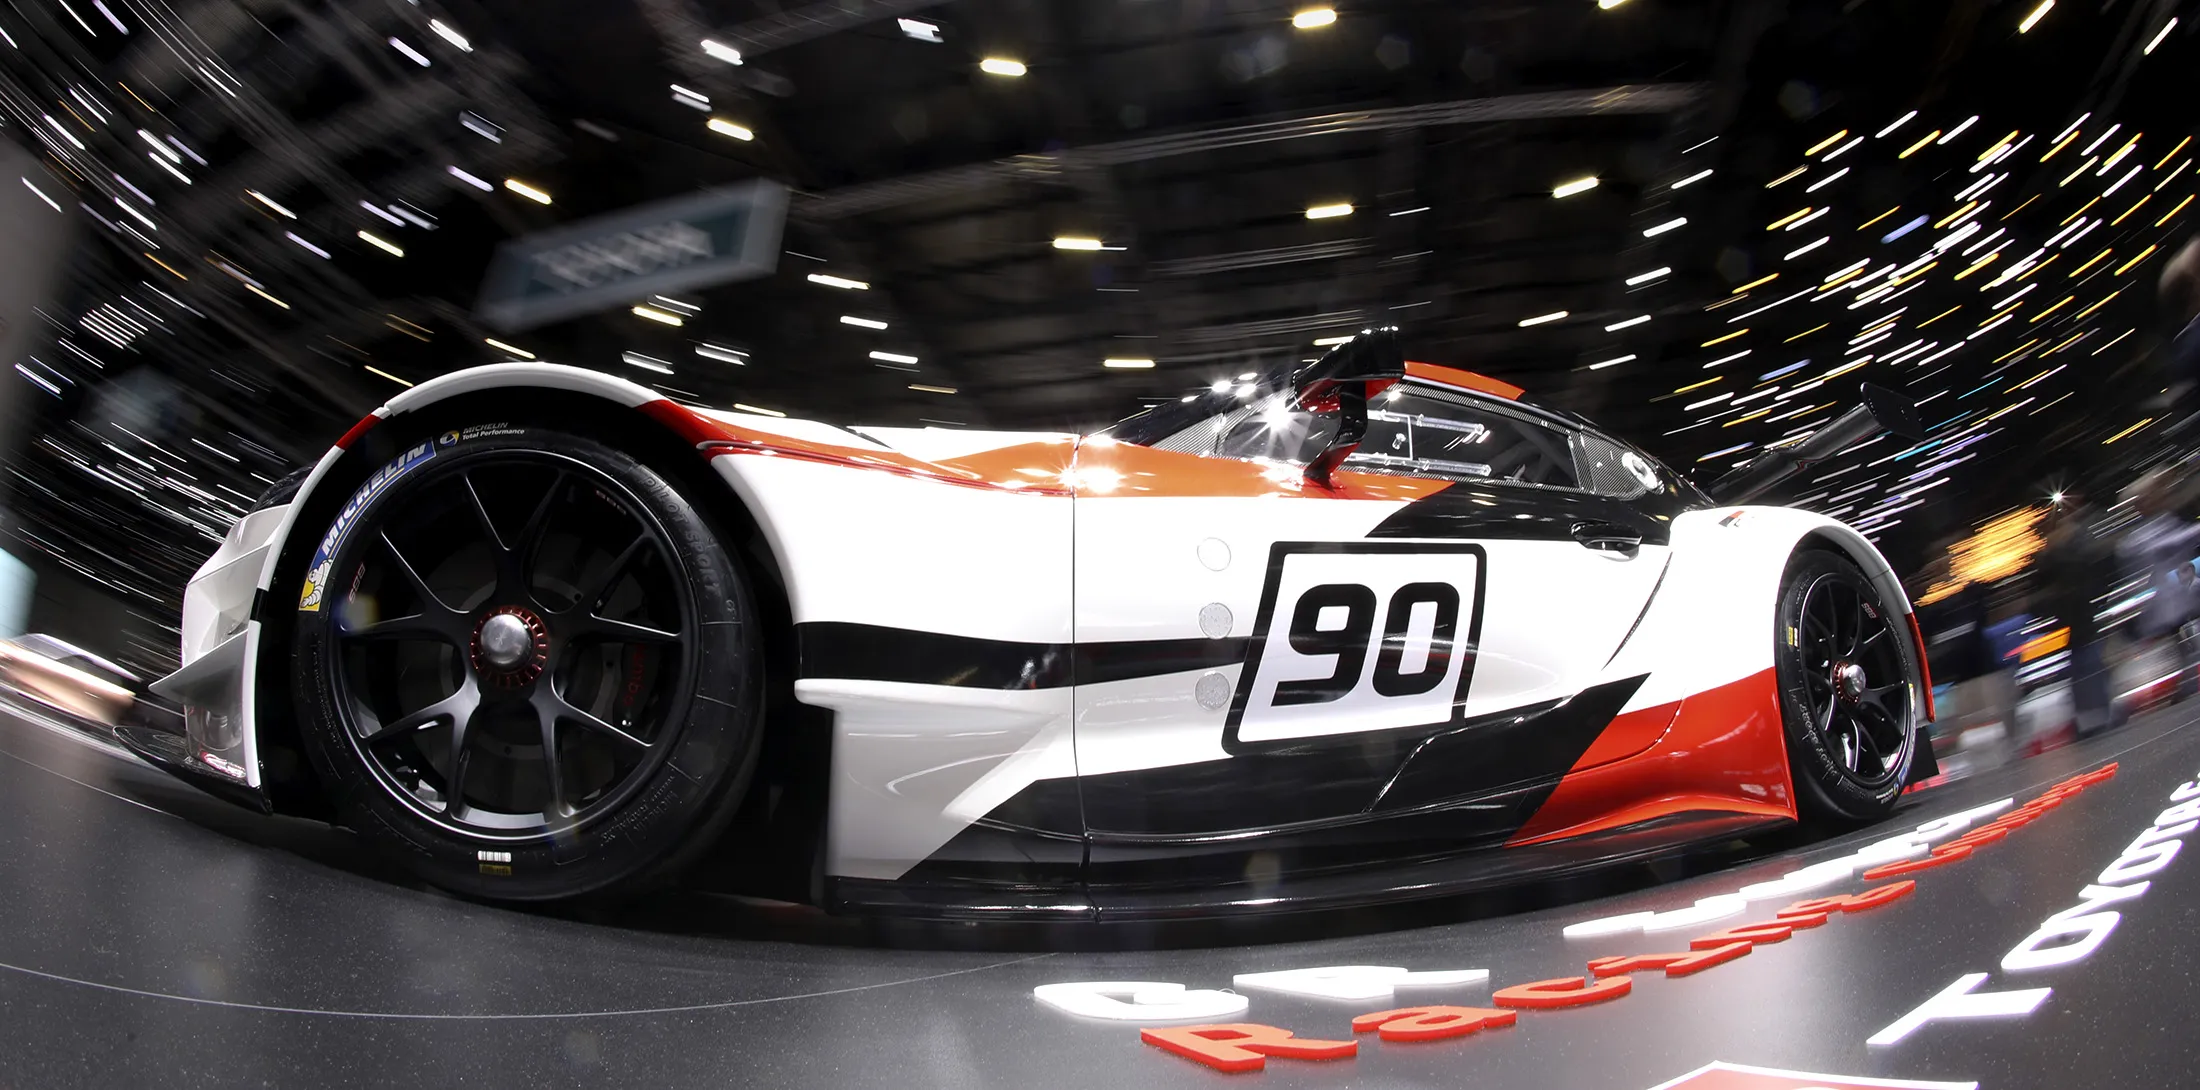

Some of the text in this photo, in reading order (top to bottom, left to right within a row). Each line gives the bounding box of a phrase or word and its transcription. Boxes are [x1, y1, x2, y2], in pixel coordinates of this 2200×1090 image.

[463, 422, 508, 434] MICHELIN
[463, 429, 525, 440] Total Performance
[322, 443, 426, 556] MICHELIN
[1271, 582, 1460, 707] 90
[1140, 880, 1917, 1072] Racing
[1867, 797, 2200, 1046] TOYOTA
